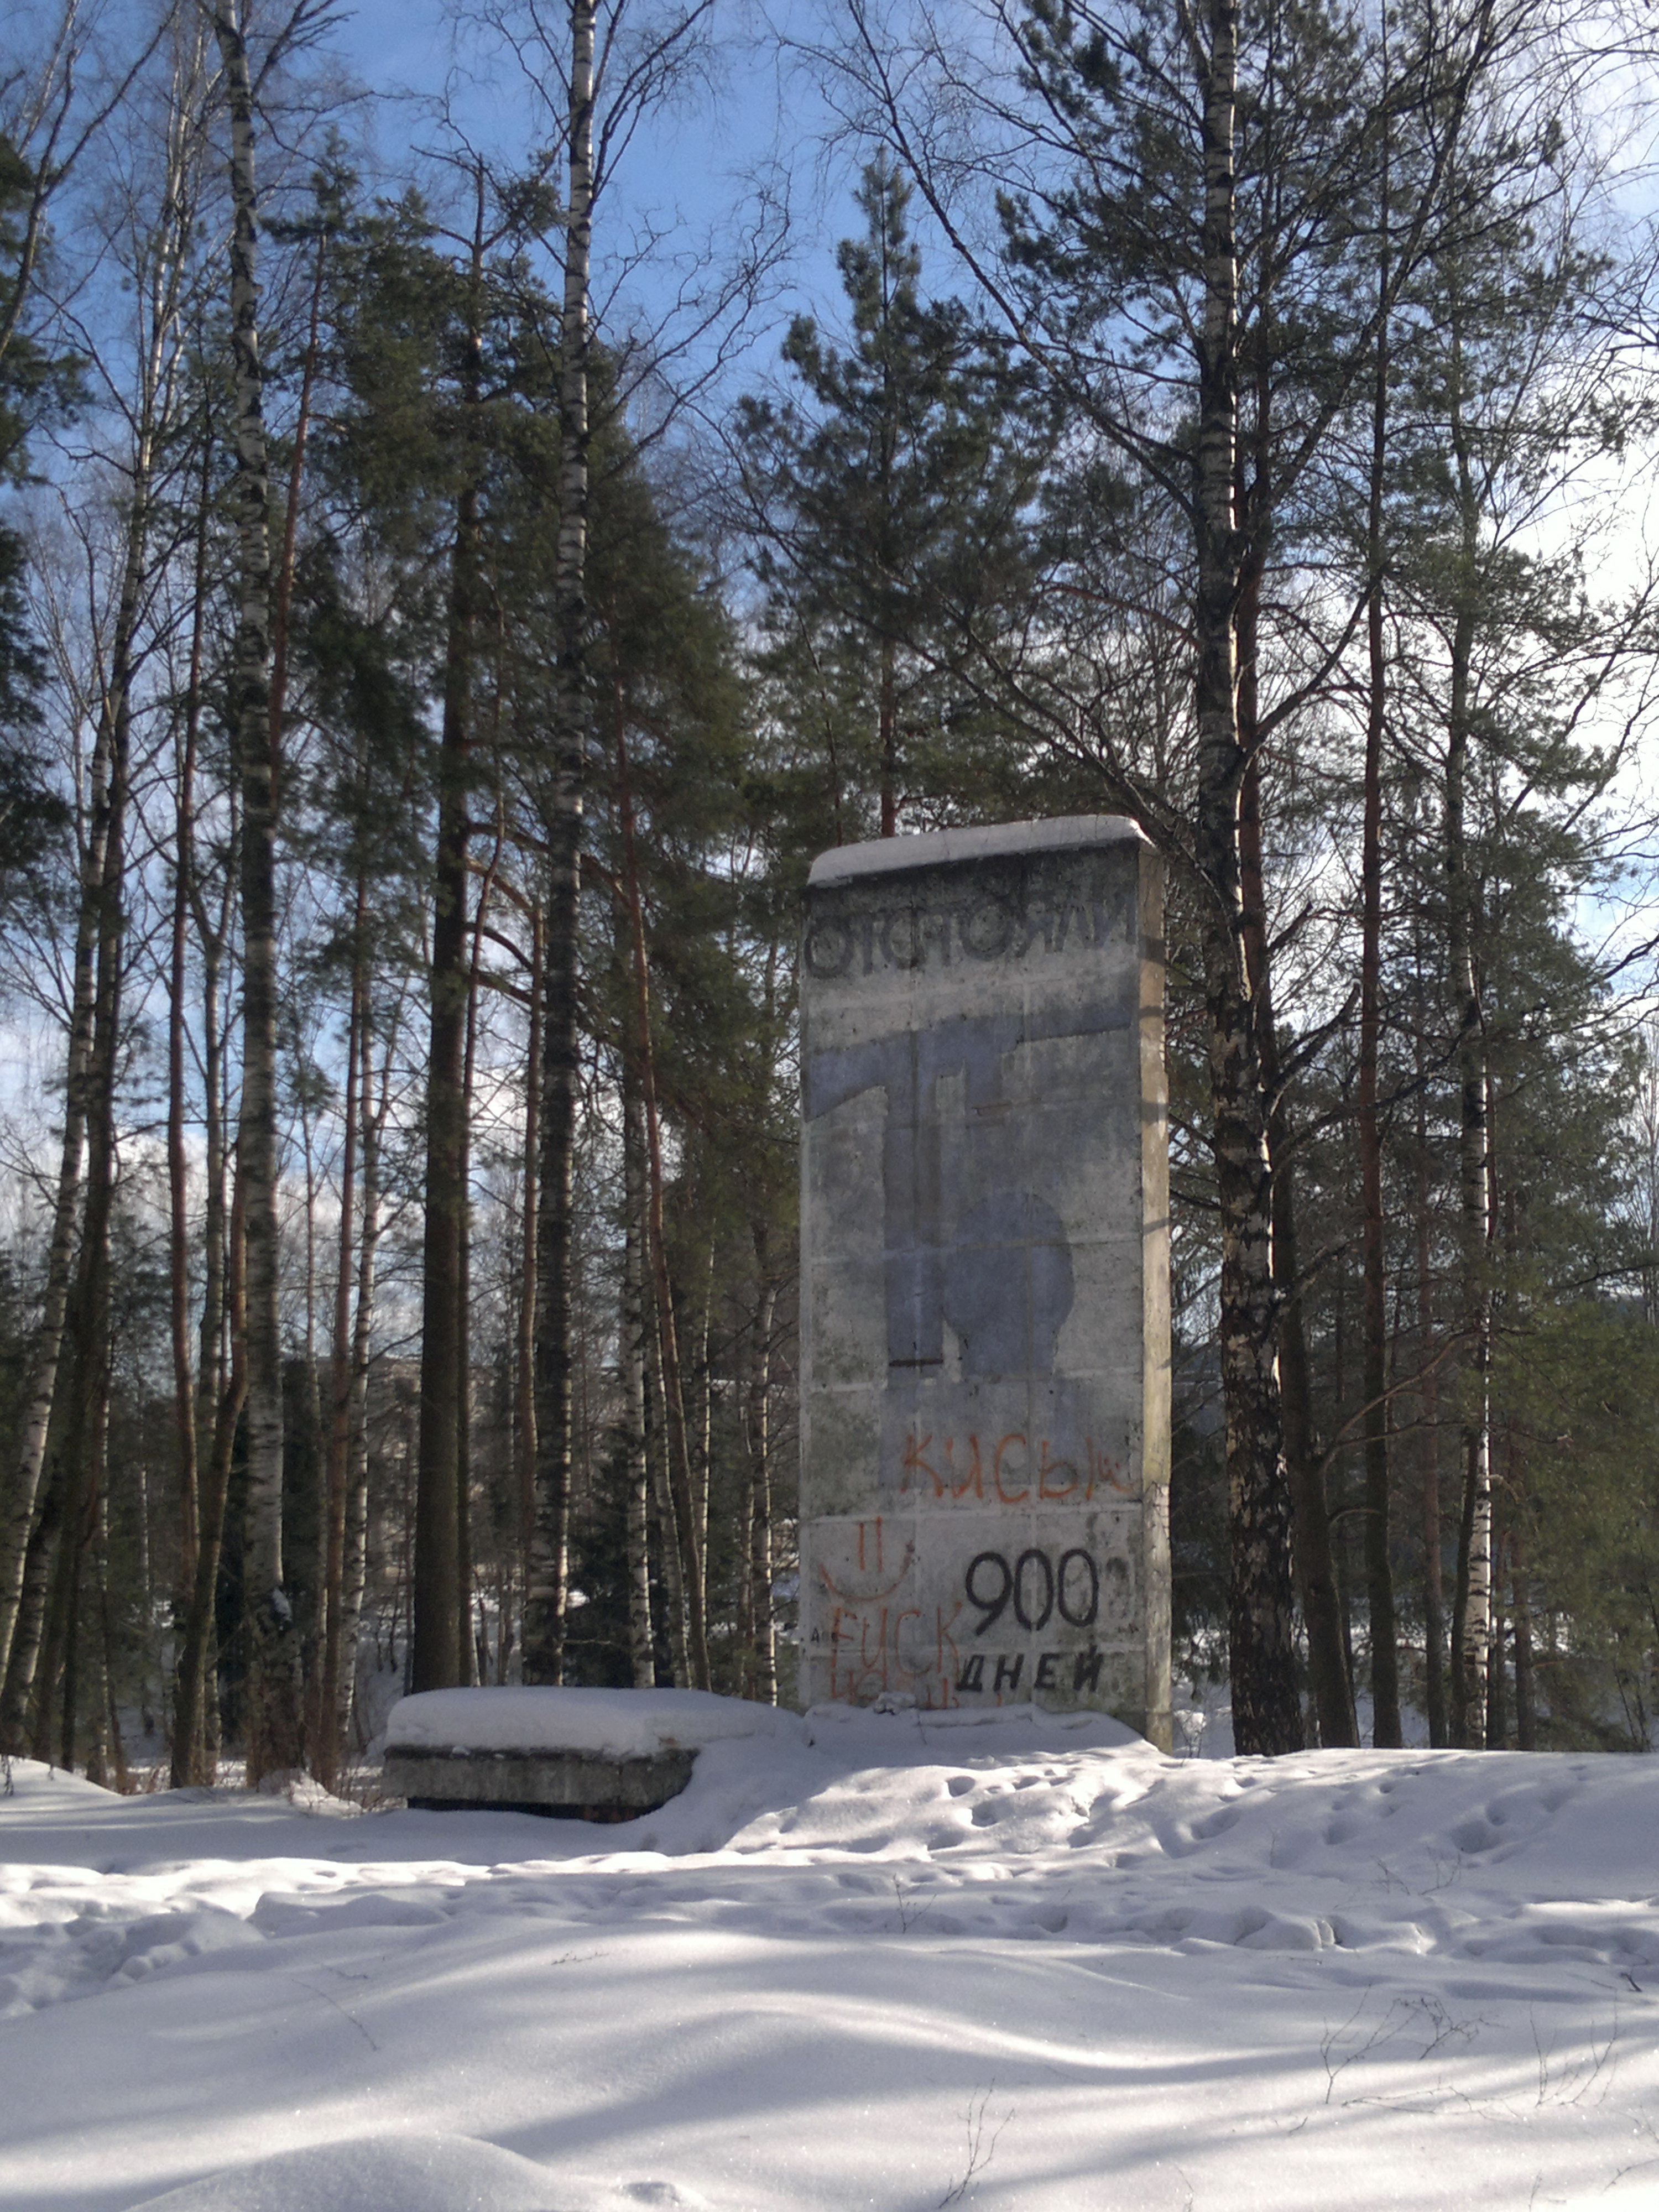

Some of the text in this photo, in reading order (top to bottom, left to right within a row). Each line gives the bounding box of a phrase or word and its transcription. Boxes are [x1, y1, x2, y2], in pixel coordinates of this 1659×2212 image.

[965, 1548, 1099, 1636] 900
[831, 1601, 963, 1684] FUCK
[954, 1644, 1104, 1692] ДНЕЙ
